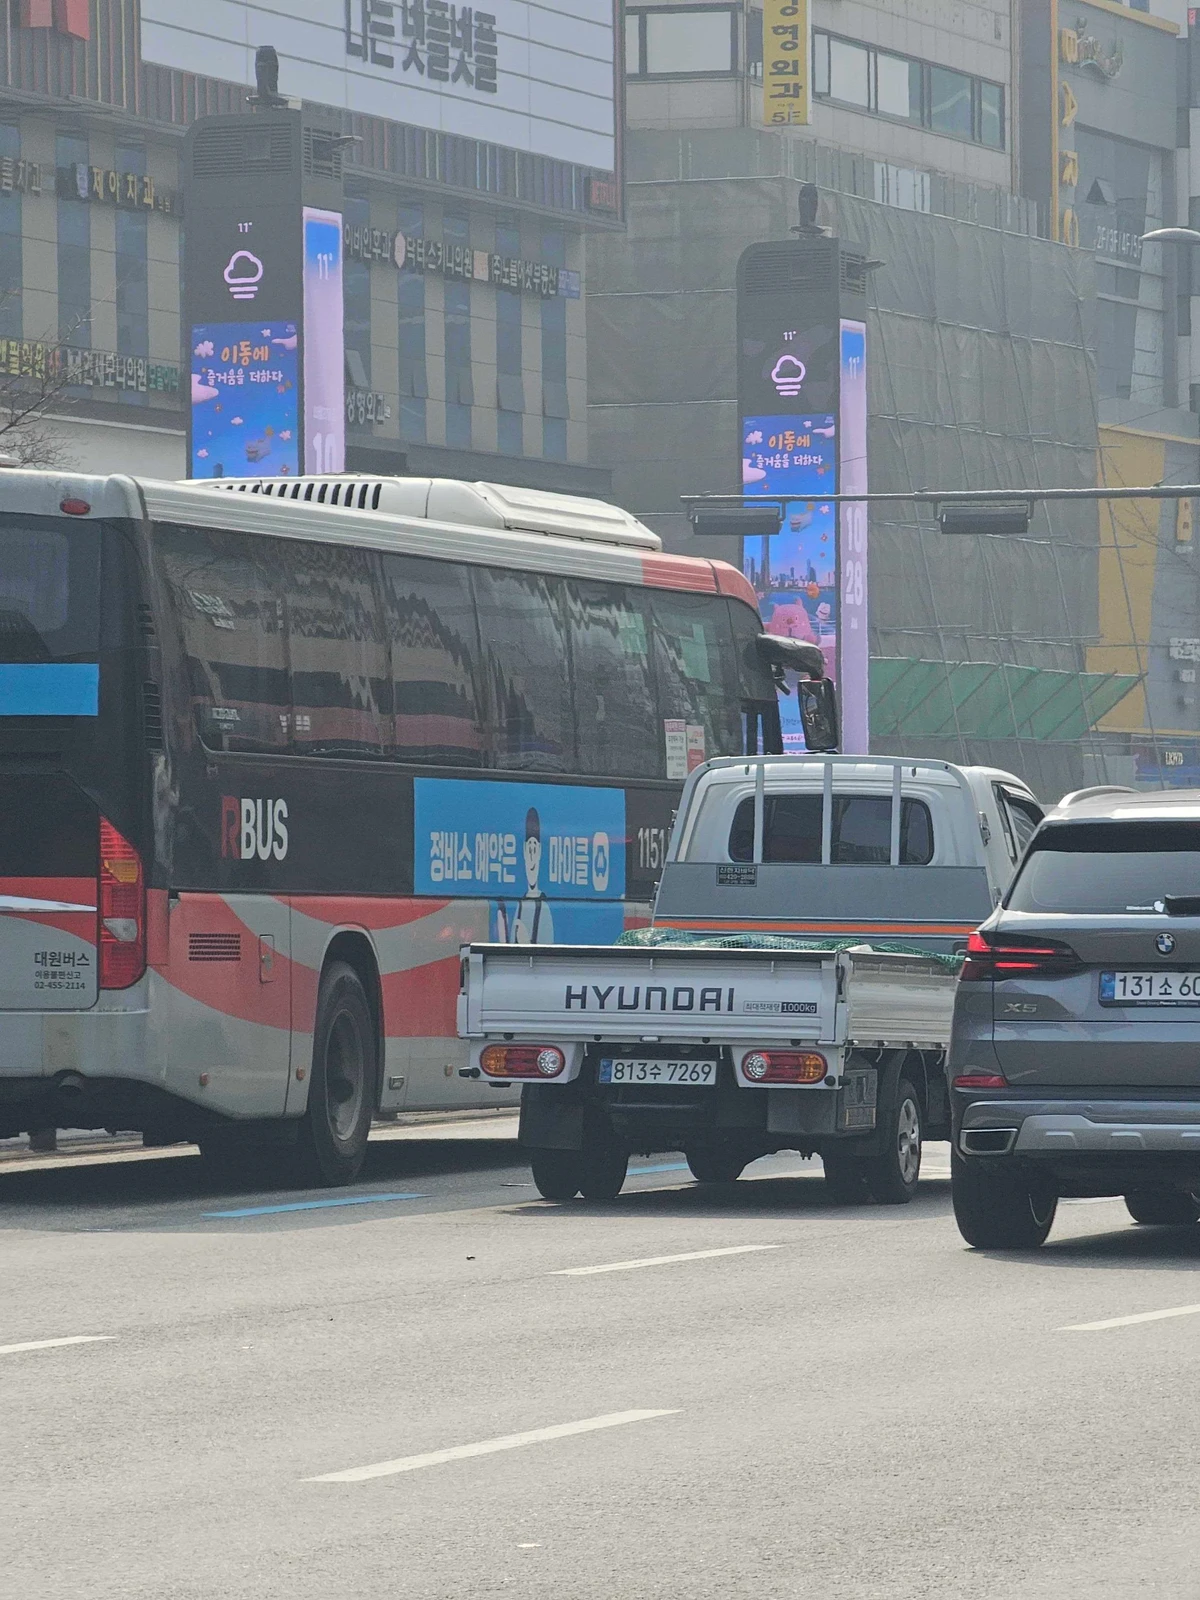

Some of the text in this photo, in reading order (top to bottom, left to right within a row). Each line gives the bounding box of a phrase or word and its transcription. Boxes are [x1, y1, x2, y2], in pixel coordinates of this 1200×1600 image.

[771, 111, 801, 123] 5F
[92, 166, 155, 209] 제아치과
[220, 340, 270, 365] 이동에
[206, 368, 283, 386] 즐거움을 더하다
[346, 391, 386, 425] 성형외과
[768, 431, 811, 451] 이동에
[755, 453, 823, 468] 즐거움을 더하다
[845, 506, 864, 553] 10
[845, 560, 865, 606] 28
[430, 831, 590, 885] 정비소 예약은 마이클
[34, 951, 90, 967] 대원버스
[34, 970, 81, 980] 이용불편신고
[34, 981, 86, 990] 02-455-2114
[1118, 975, 1173, 997] 131소
[565, 985, 735, 1012] HYUNDAI
[782, 1003, 816, 1013] 1000kg
[1003, 1002, 1038, 1013] X5
[613, 1062, 713, 1082] 813수 7269
